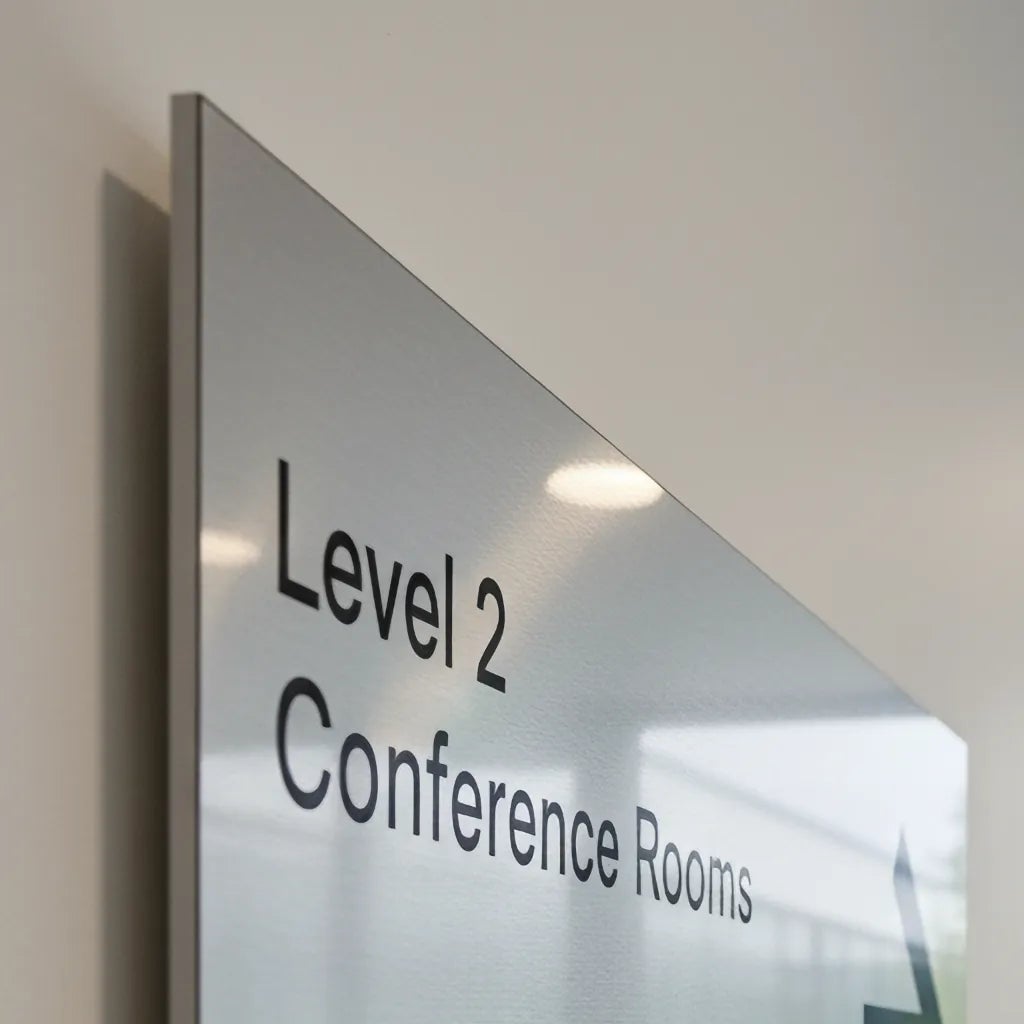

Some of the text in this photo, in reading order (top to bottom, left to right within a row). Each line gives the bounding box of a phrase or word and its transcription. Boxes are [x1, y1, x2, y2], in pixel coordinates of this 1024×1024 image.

[276, 457, 506, 694] Level 2
[276, 676, 753, 925] Conference Rooms
